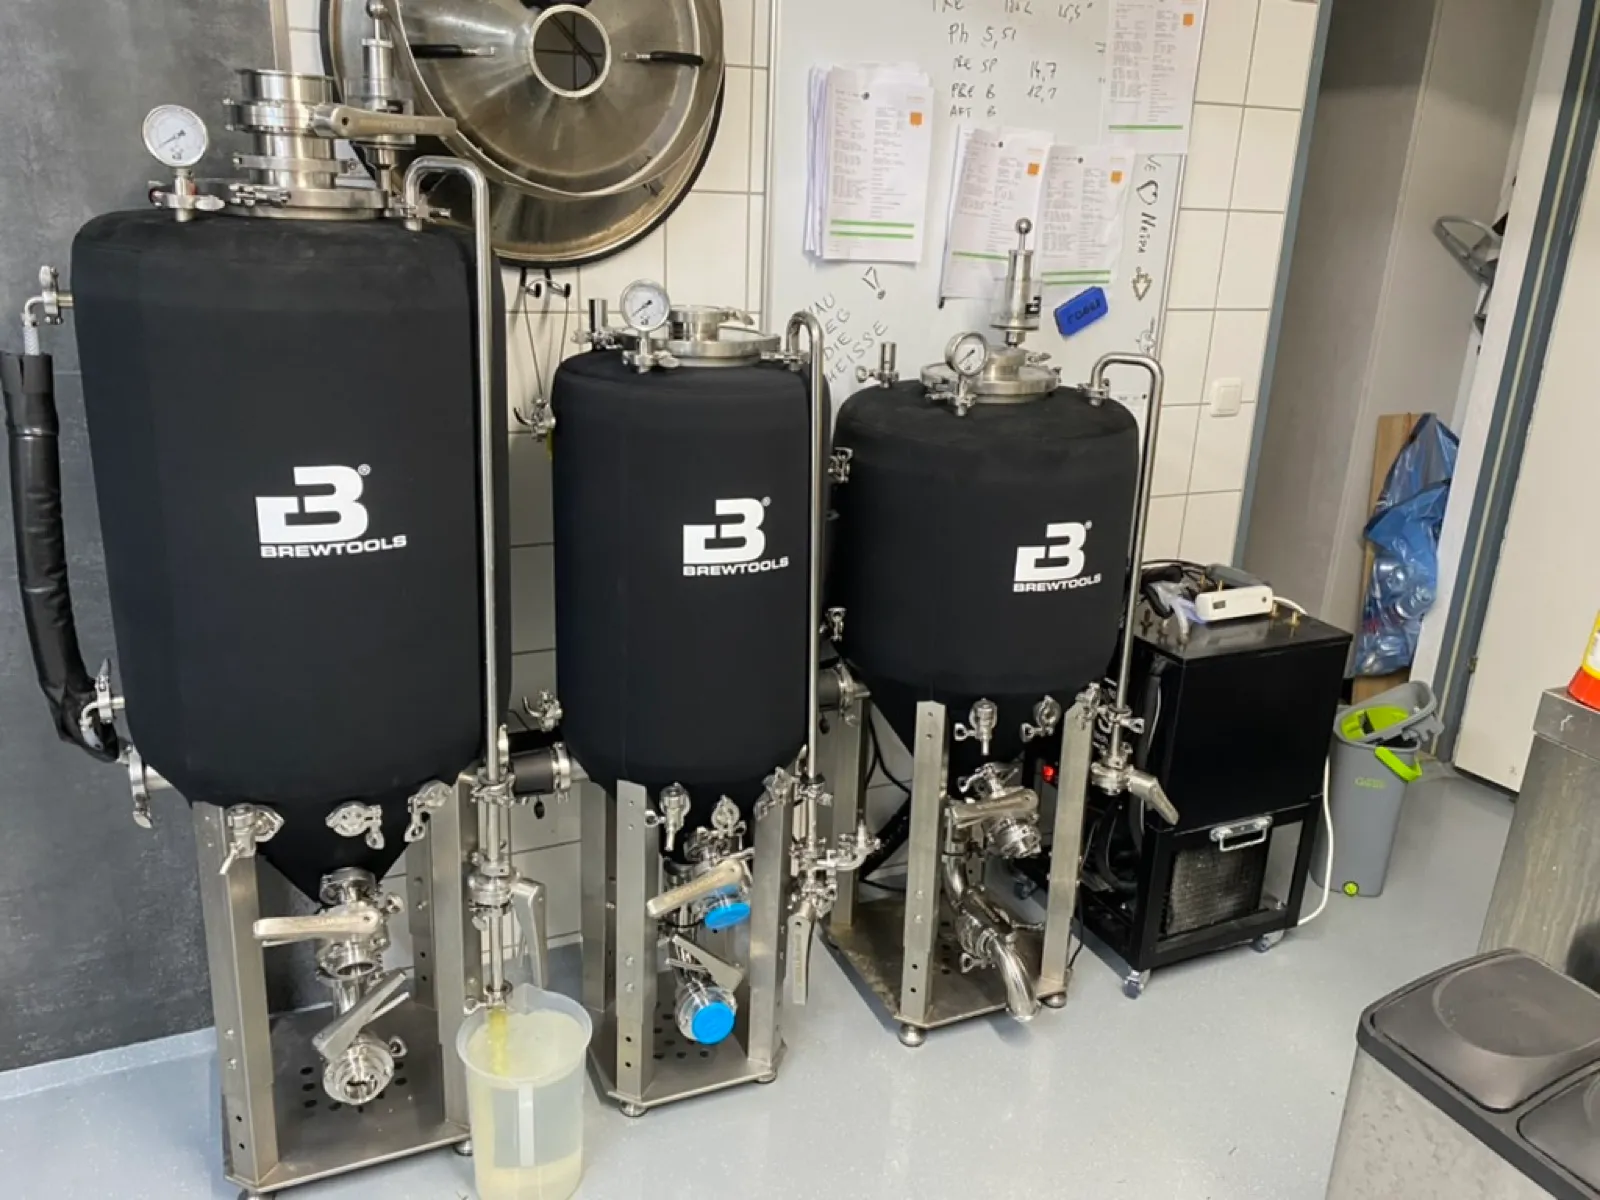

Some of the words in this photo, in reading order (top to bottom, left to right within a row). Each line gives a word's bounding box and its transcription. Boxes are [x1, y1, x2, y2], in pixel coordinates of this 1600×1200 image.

[825, 311, 850, 335] EG
[823, 331, 852, 361] DIE
[825, 320, 889, 383] HEISSE
[260, 534, 407, 559] BREWTOOLS
[682, 556, 790, 576] BREWTOOLS
[1012, 573, 1102, 592] BREWTOOLS
